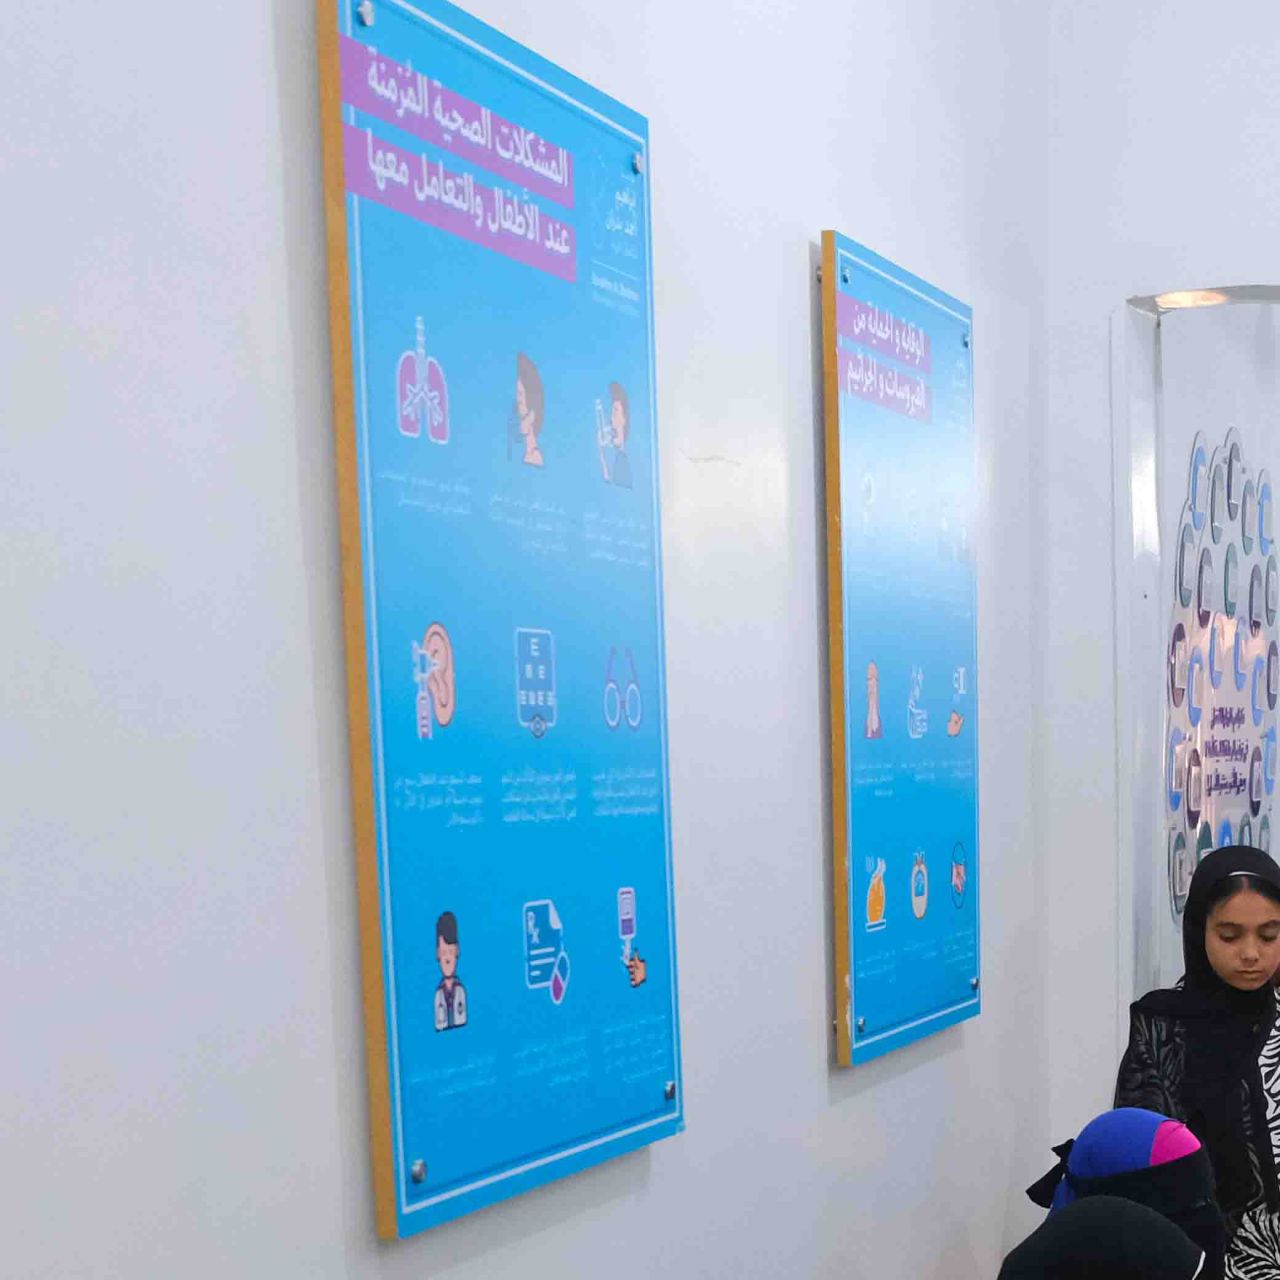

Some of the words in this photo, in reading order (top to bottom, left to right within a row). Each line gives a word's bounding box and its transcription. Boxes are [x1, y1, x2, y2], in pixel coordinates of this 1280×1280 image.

[433, 80, 492, 149] الصحية
[366, 128, 409, 191] معها
[496, 126, 568, 188] المشكلات
[414, 152, 484, 228] والتعامل
[545, 225, 571, 254] عند
[853, 305, 866, 335] من
[867, 301, 893, 344] الحماية
[901, 318, 925, 364] الوقاية
[847, 348, 877, 394] الجراثيم
[885, 369, 926, 415] الفيروسات
